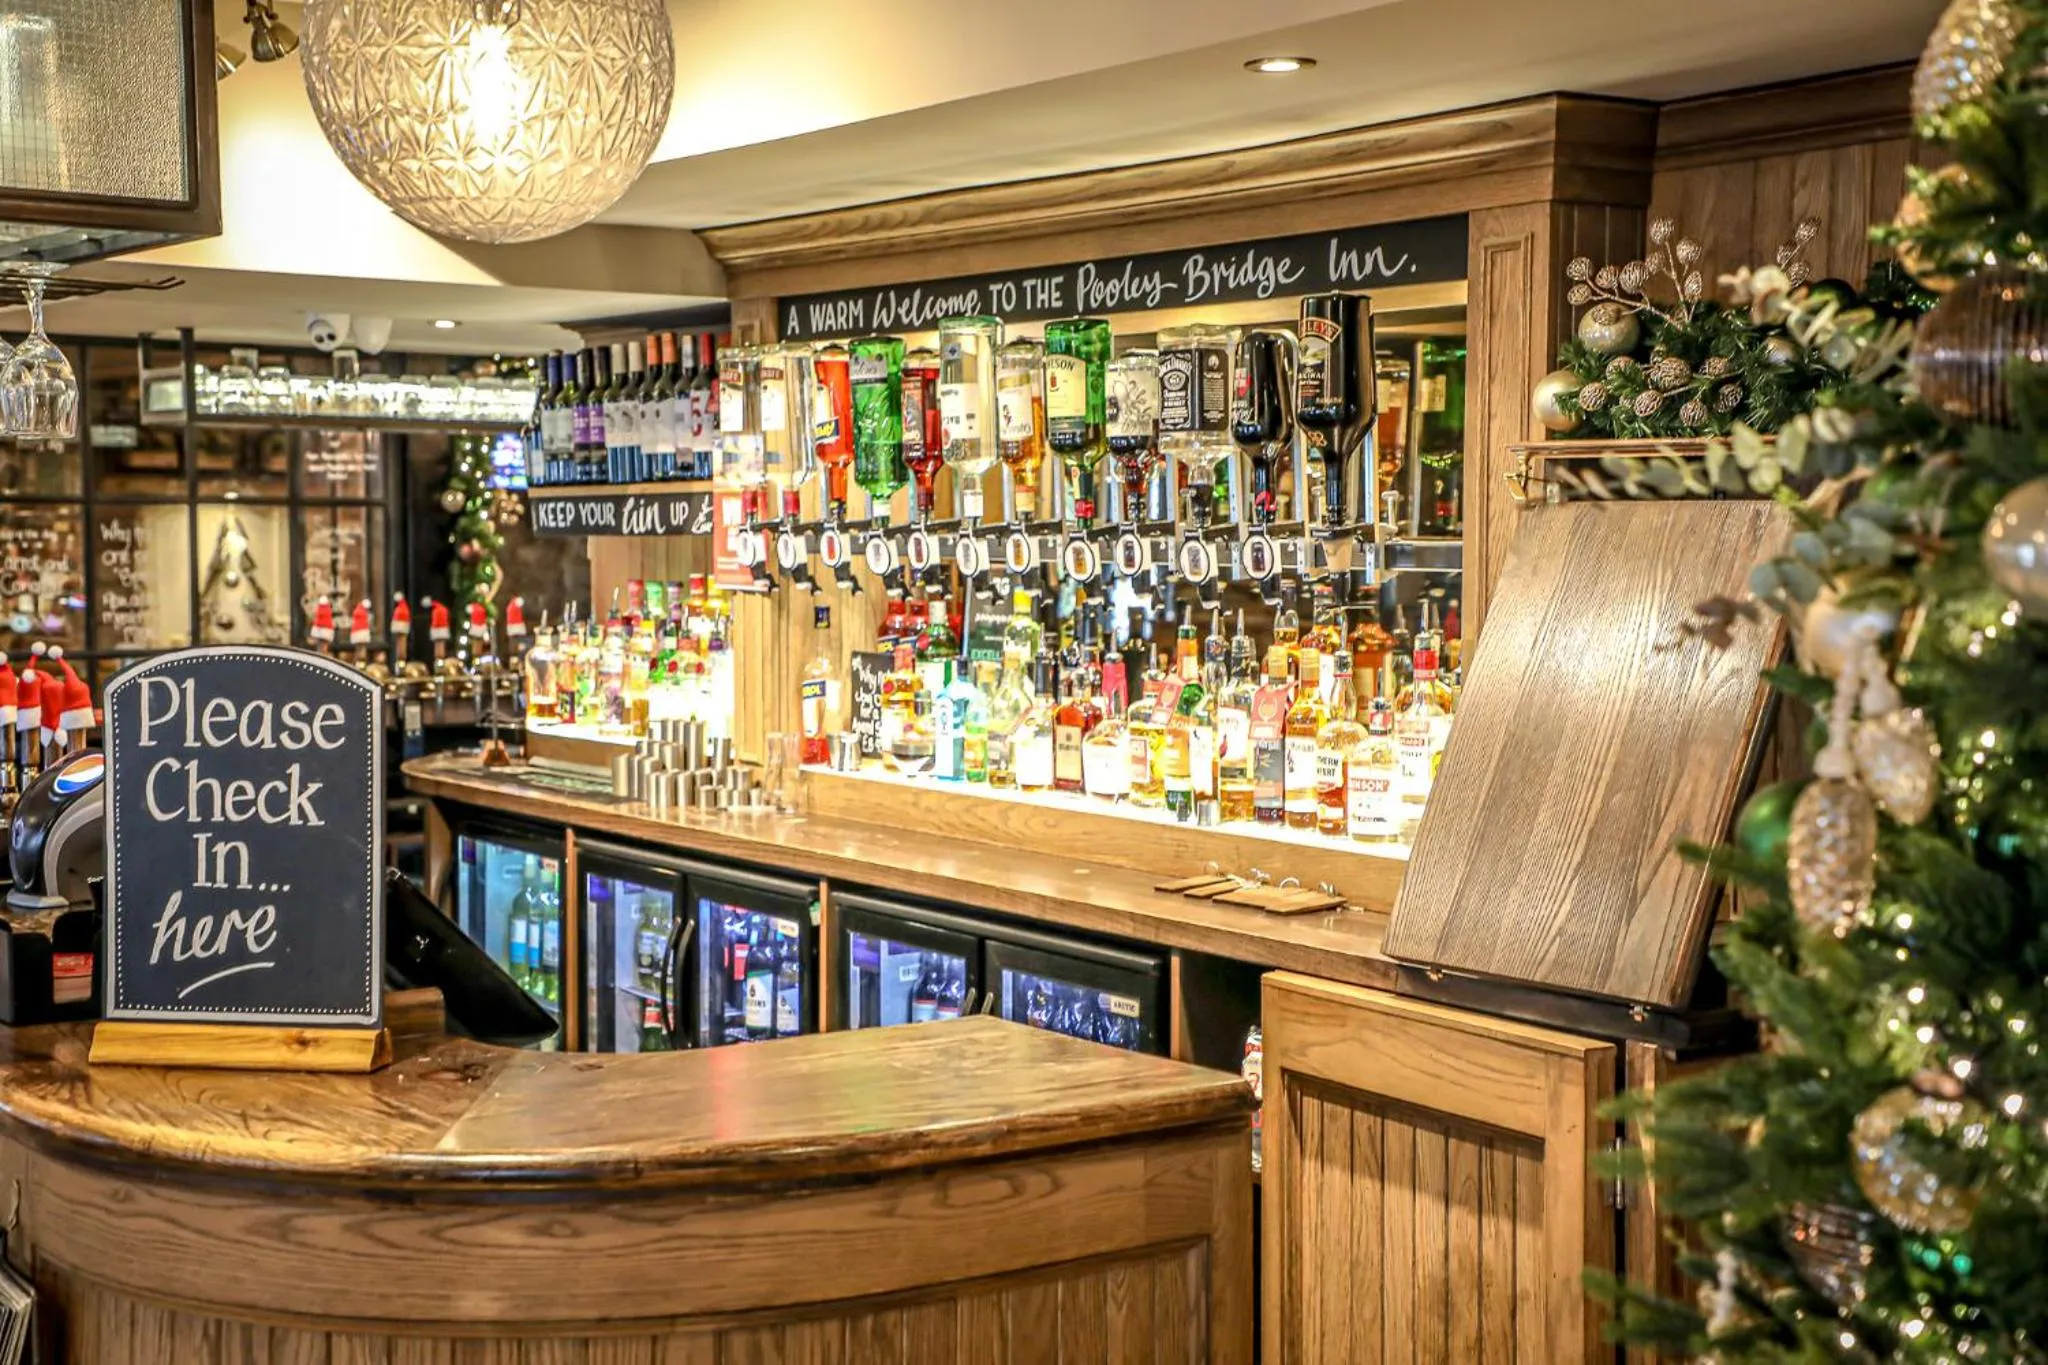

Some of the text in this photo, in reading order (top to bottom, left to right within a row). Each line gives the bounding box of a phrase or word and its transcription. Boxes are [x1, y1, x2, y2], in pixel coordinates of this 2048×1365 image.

[786, 237, 1417, 335] A WARM Welcome TO THE Pooley Bridge Inn.
[538, 500, 576, 528] KEEP
[579, 501, 616, 527] YOUR
[670, 500, 690, 527] UP
[137, 675, 346, 750] Please
[145, 756, 326, 827] Check
[192, 832, 292, 893] In...
[149, 890, 278, 966] here
